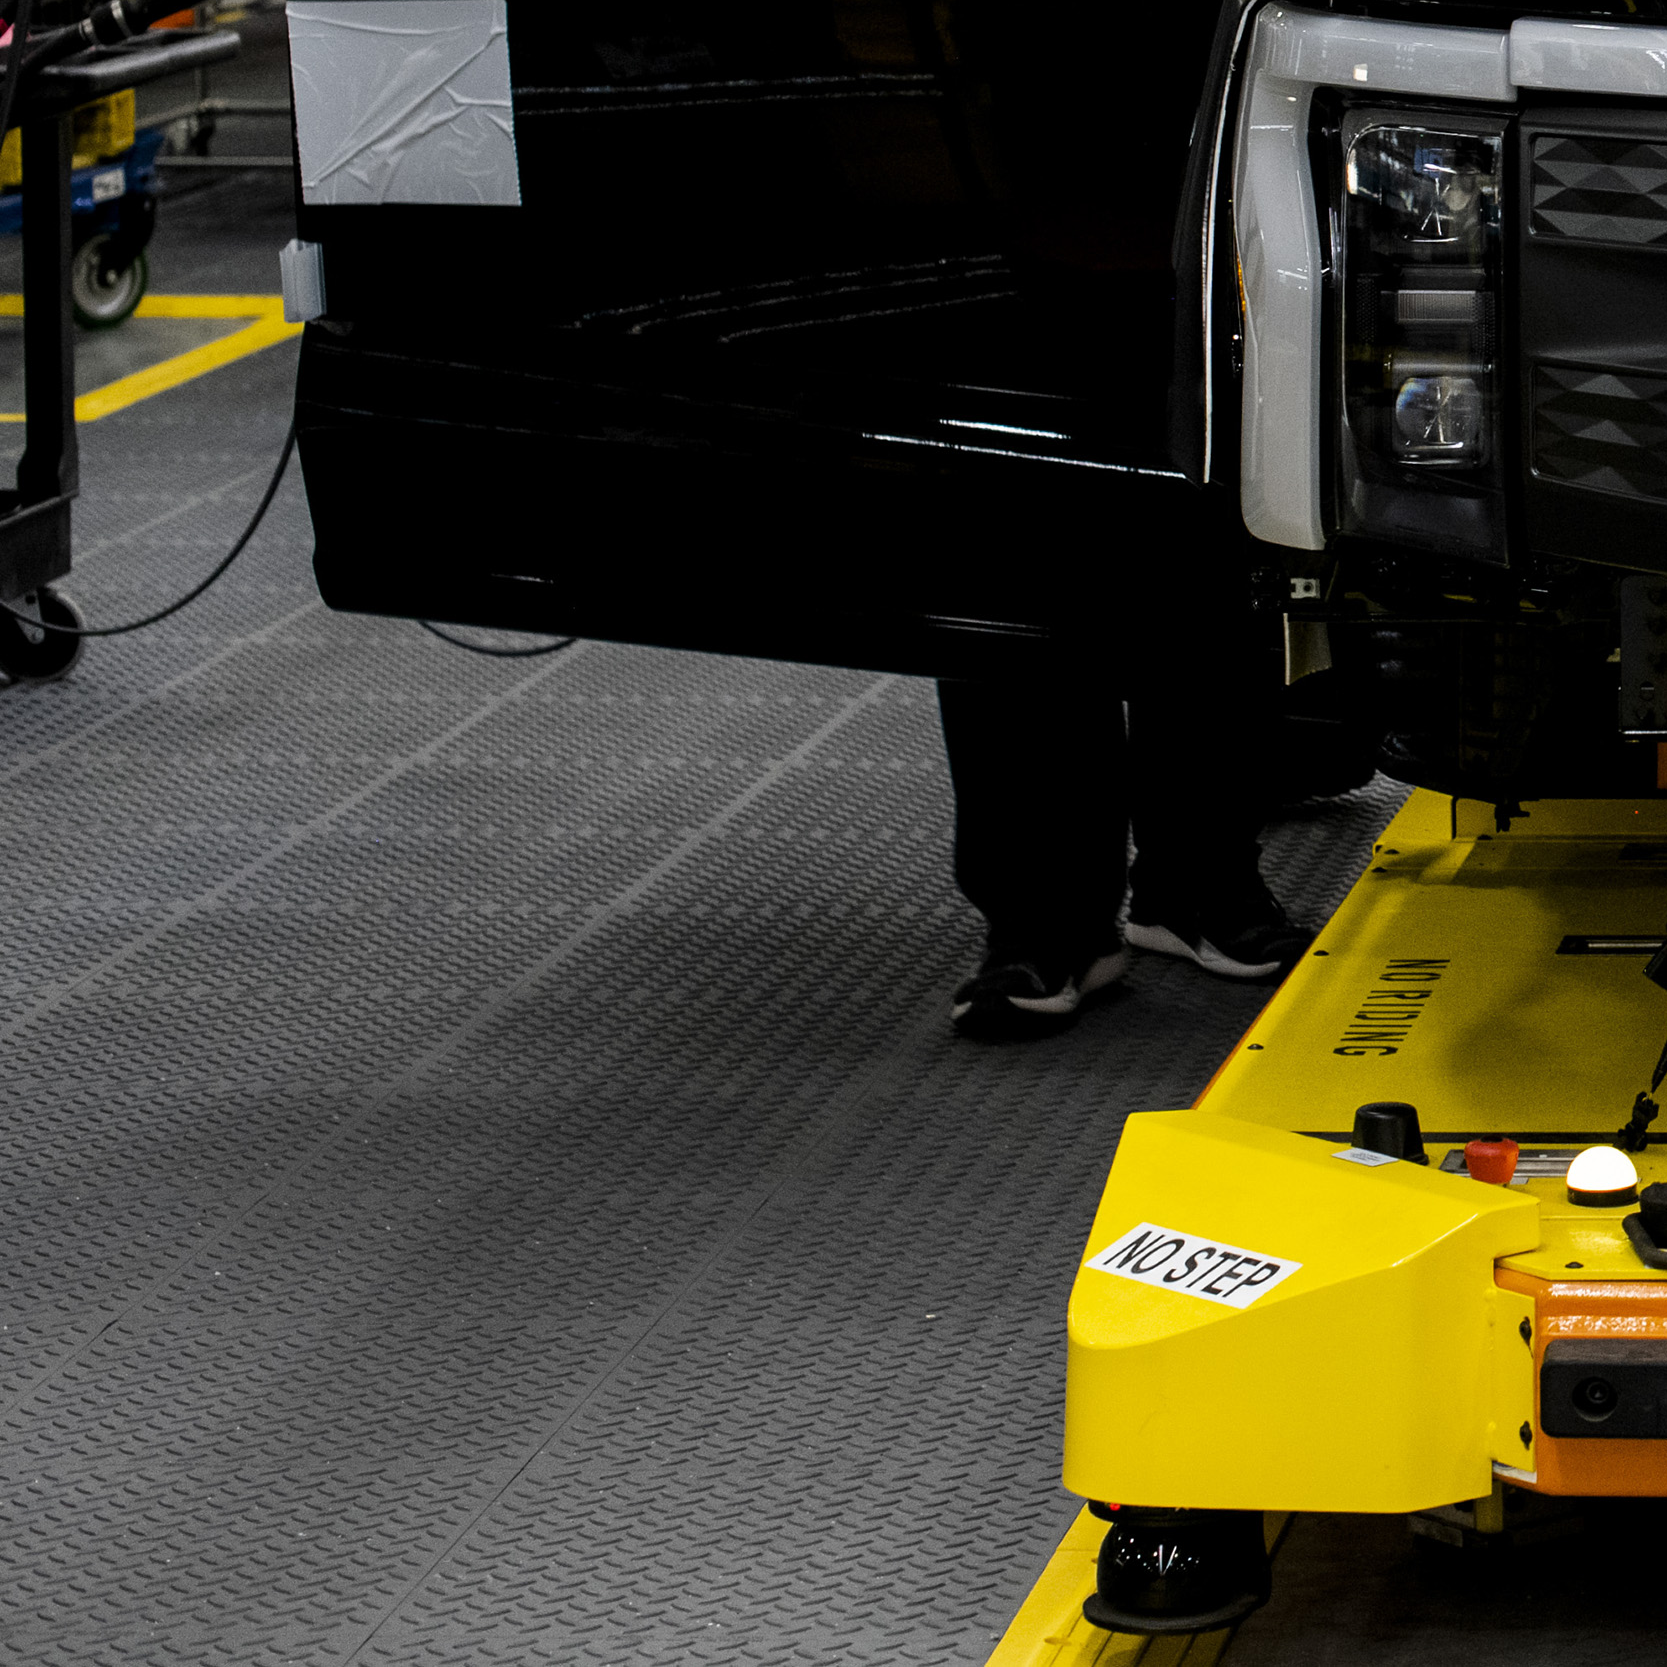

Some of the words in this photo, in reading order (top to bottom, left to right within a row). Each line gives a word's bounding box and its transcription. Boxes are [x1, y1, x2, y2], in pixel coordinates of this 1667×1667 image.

[1380, 959, 1450, 982] NO
[1333, 990, 1432, 1056] RIDING
[1103, 1230, 1186, 1274] NO
[1162, 1246, 1281, 1298] STEP
